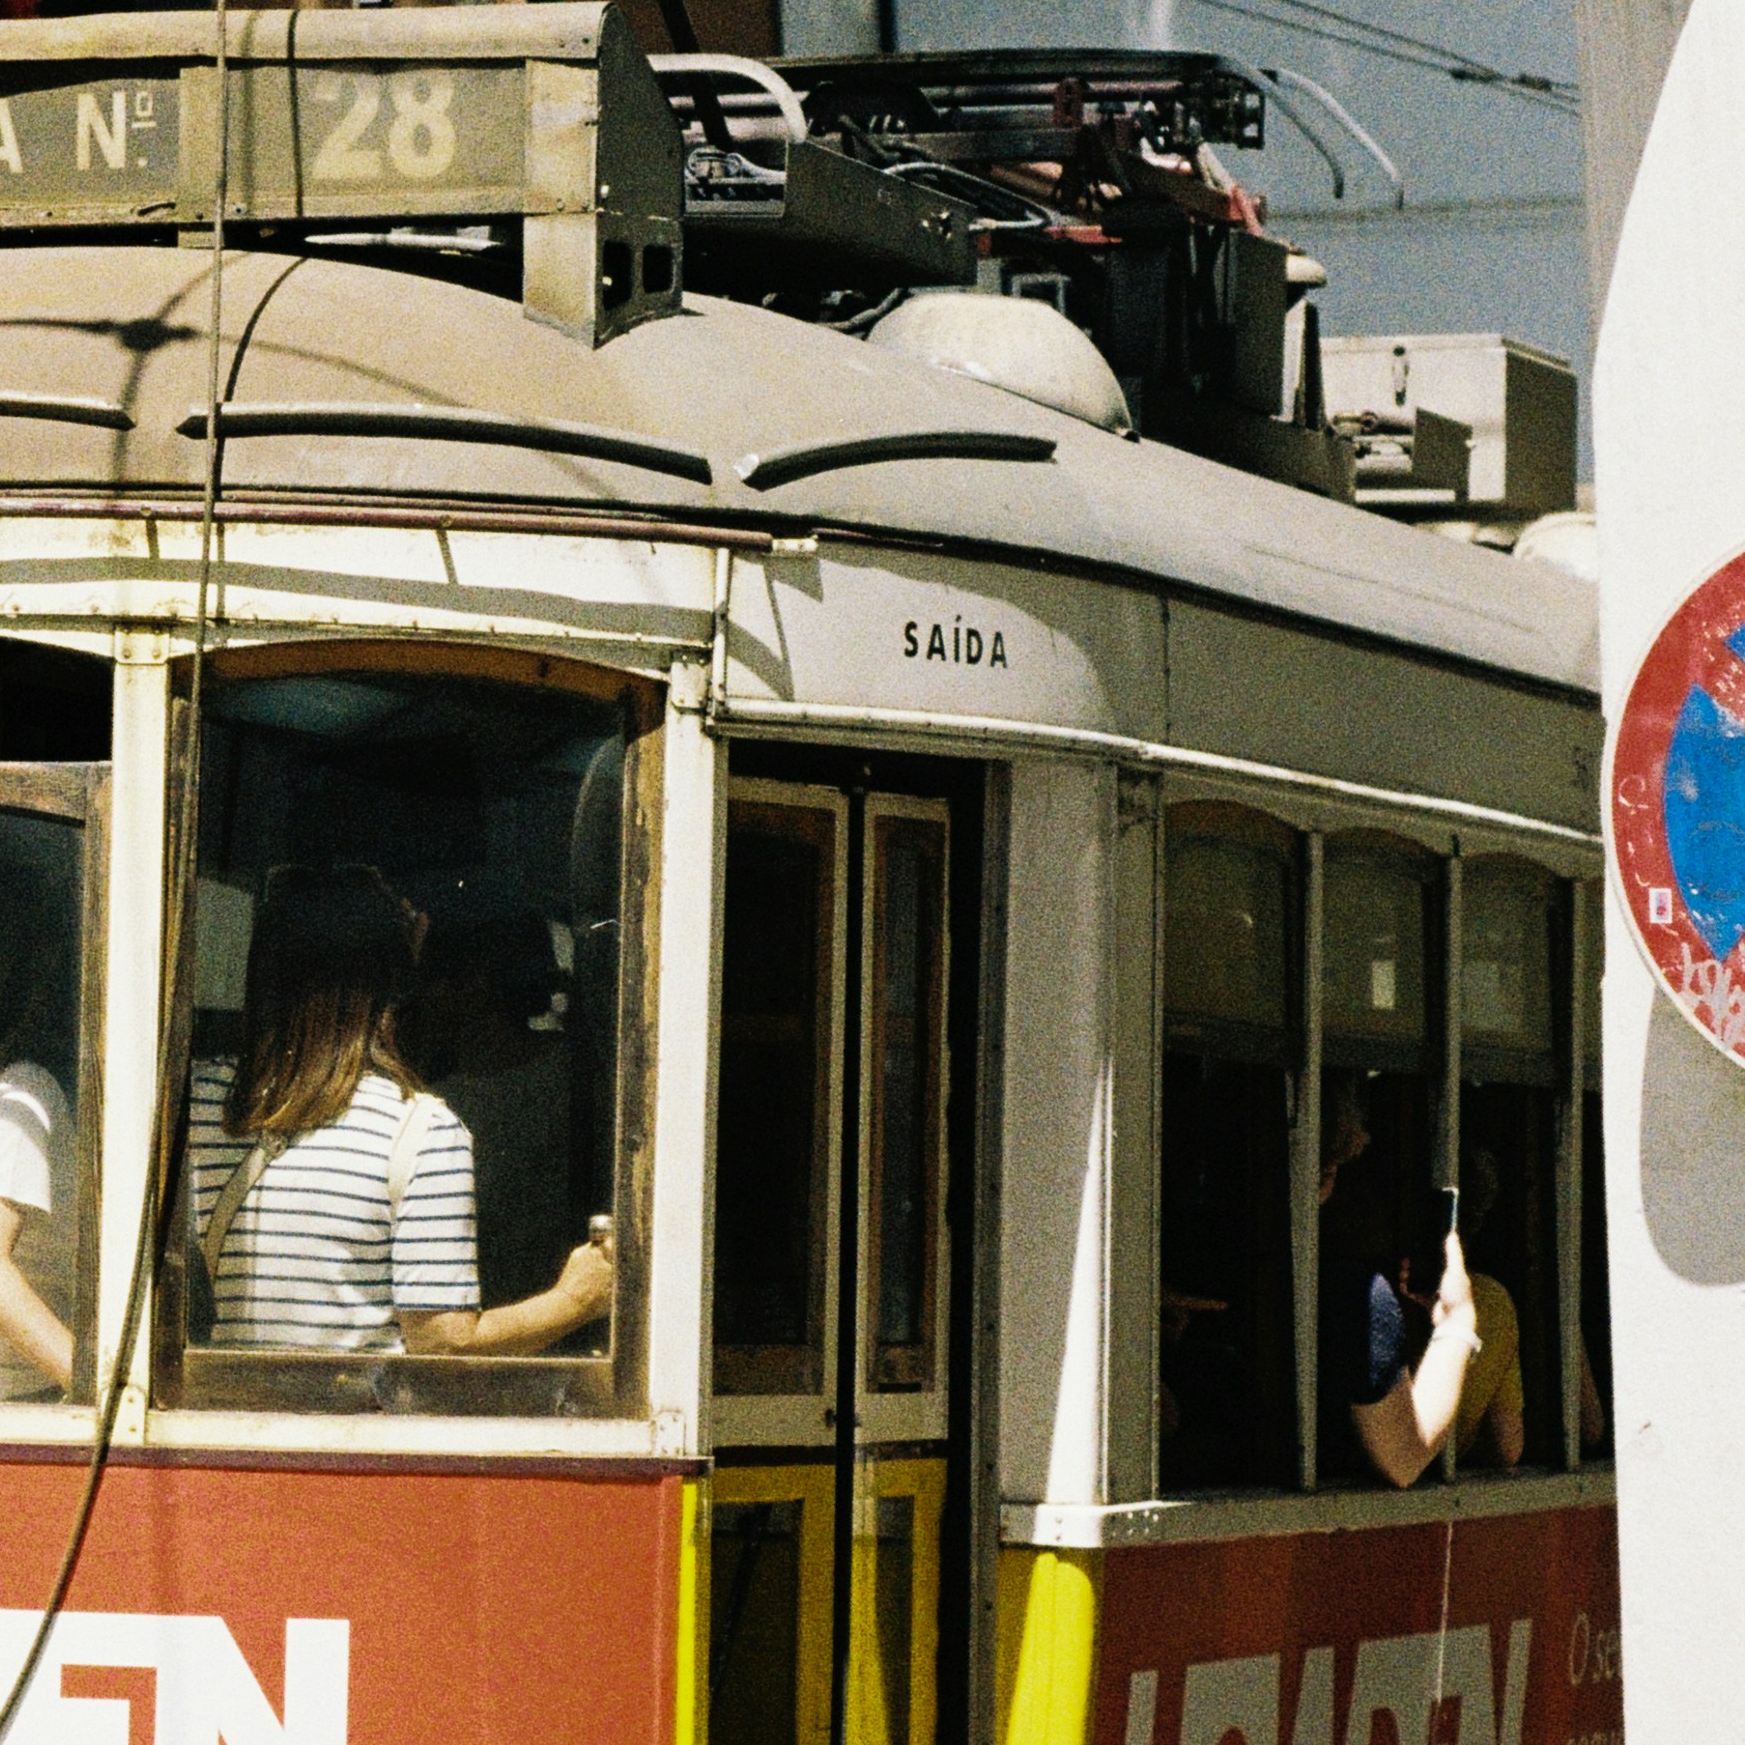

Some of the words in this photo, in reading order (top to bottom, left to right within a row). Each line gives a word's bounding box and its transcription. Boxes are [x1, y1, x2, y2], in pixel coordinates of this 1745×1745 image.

[311, 70, 457, 180] 28
[904, 614, 1008, 669] SAÍDA
[1568, 1611, 1590, 1686] O
